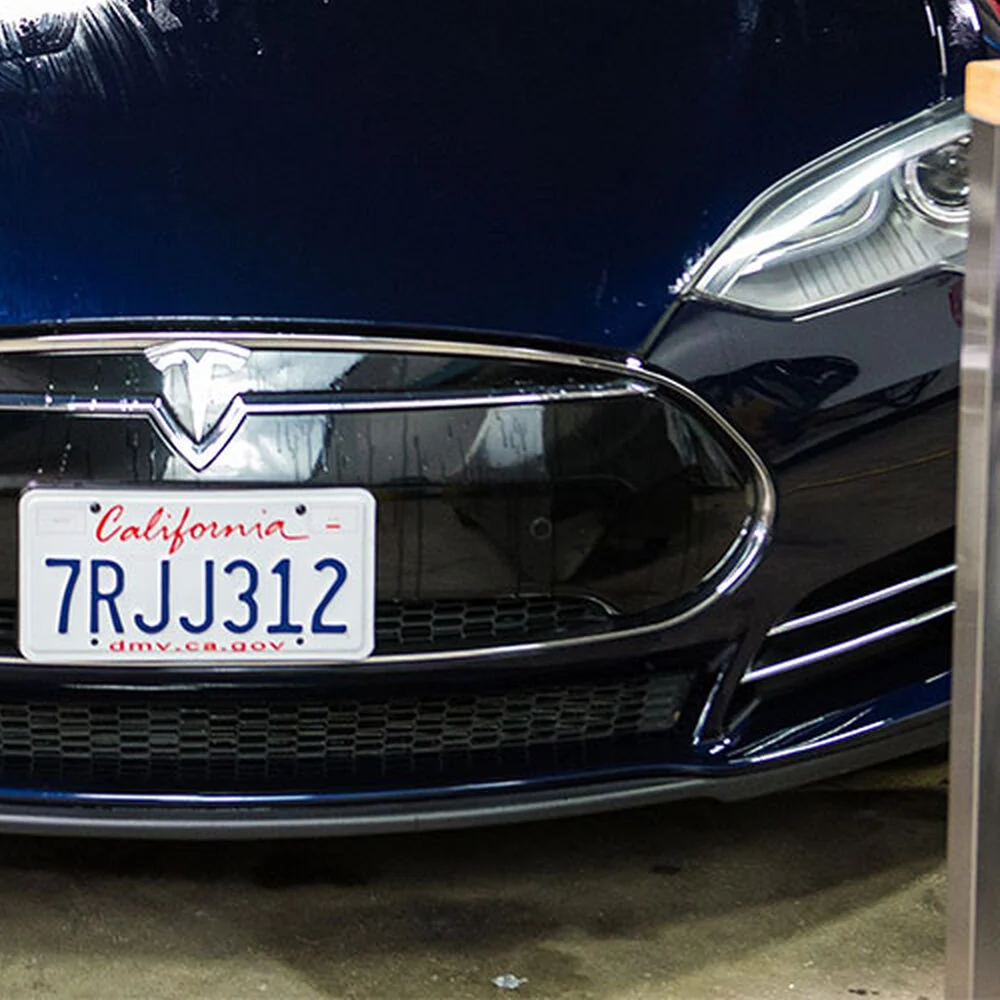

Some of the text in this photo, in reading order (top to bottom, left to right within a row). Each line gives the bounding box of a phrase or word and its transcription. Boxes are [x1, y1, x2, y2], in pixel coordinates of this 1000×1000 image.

[95, 504, 310, 554] California
[45, 557, 348, 635] 7RJJ312
[109, 639, 285, 653] dmv.ca.gov
